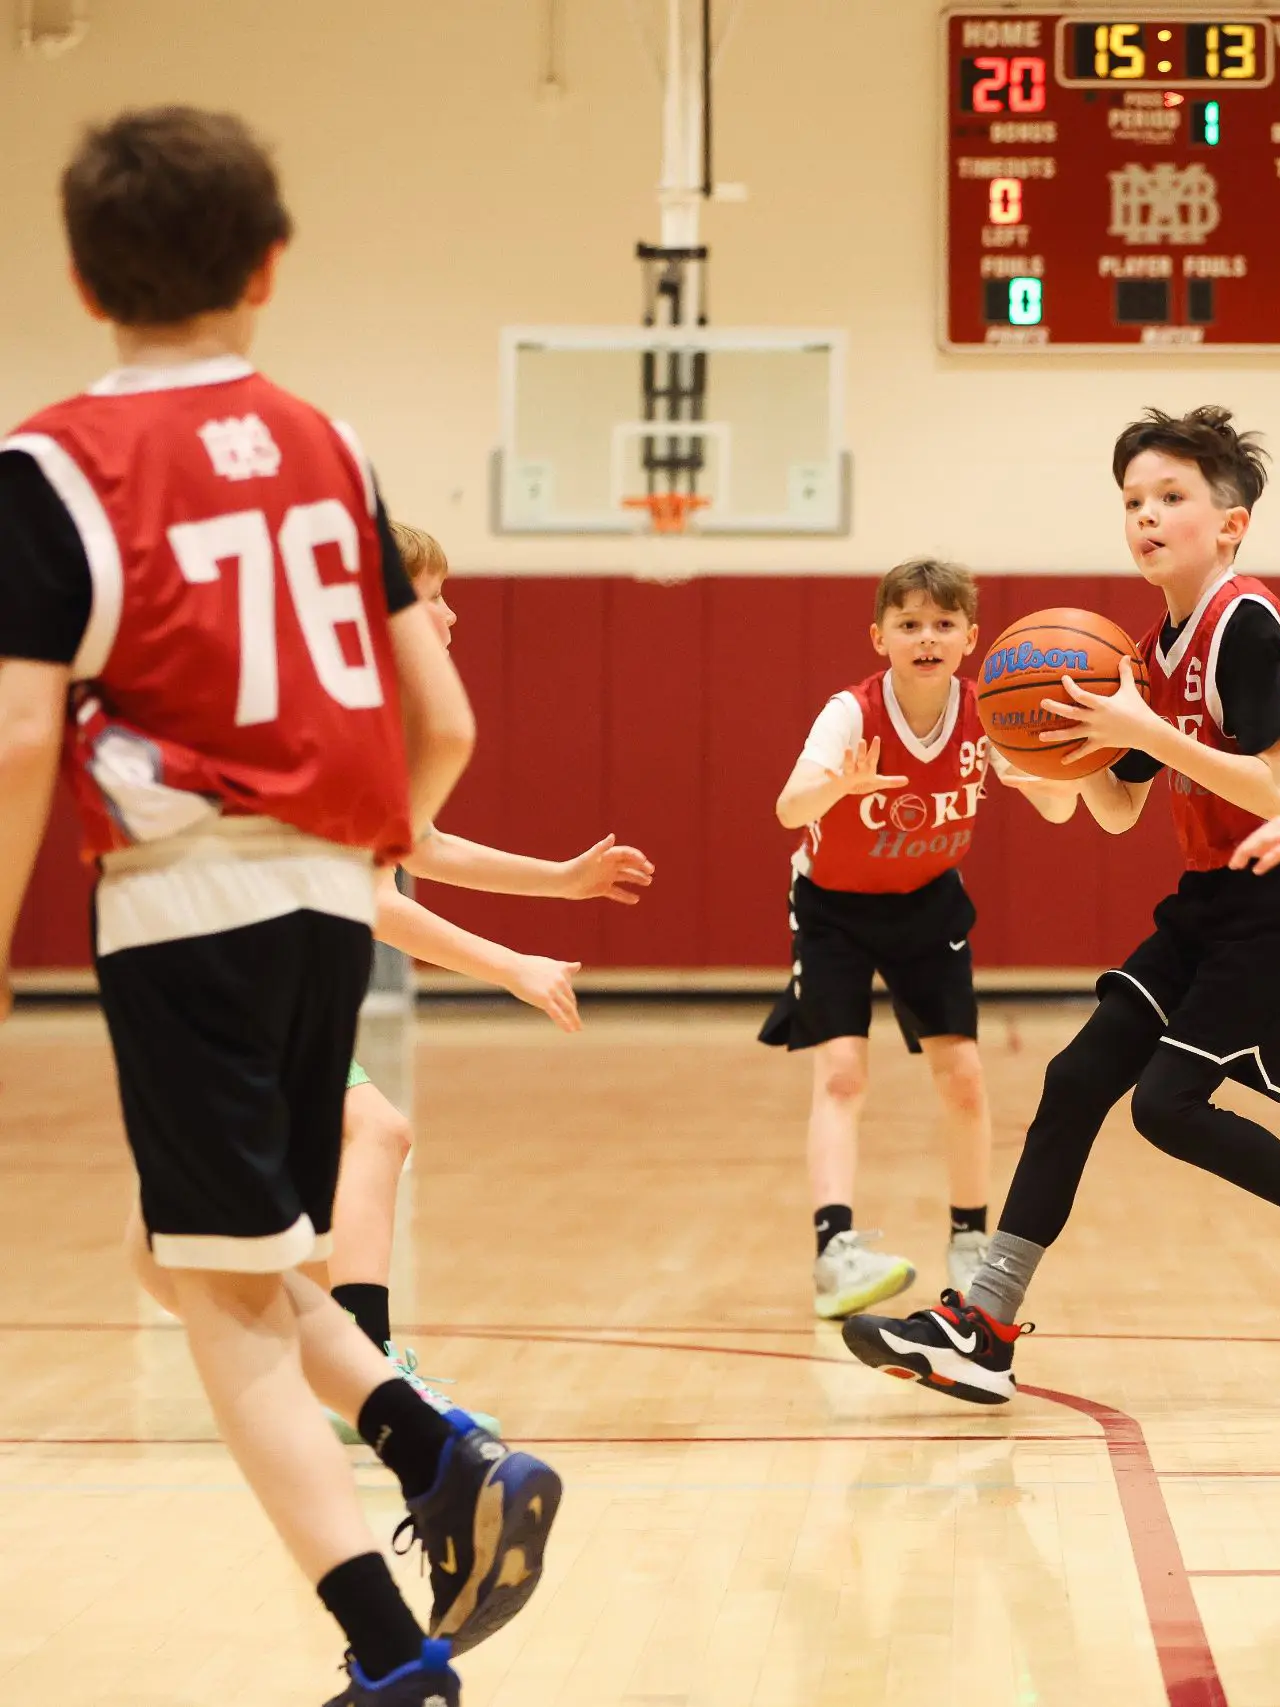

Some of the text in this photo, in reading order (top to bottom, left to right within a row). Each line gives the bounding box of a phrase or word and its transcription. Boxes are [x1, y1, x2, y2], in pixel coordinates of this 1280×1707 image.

[963, 22, 1041, 48] HOME
[972, 57, 1046, 112] 20
[1108, 109, 1181, 130] PERIOD
[1205, 101, 1219, 145] 1
[990, 122, 1057, 143] BONUS
[958, 157, 1056, 179] TIMEOUTS
[989, 177, 1022, 224] 0
[981, 225, 1030, 248] LEFT
[981, 255, 1045, 278] FOULS
[1098, 255, 1246, 278] PLAYER FOULS
[1009, 277, 1042, 326] 0
[166, 499, 385, 727] 76
[984, 641, 1089, 684] Wilson
[992, 706, 1062, 725] EVOLUT
